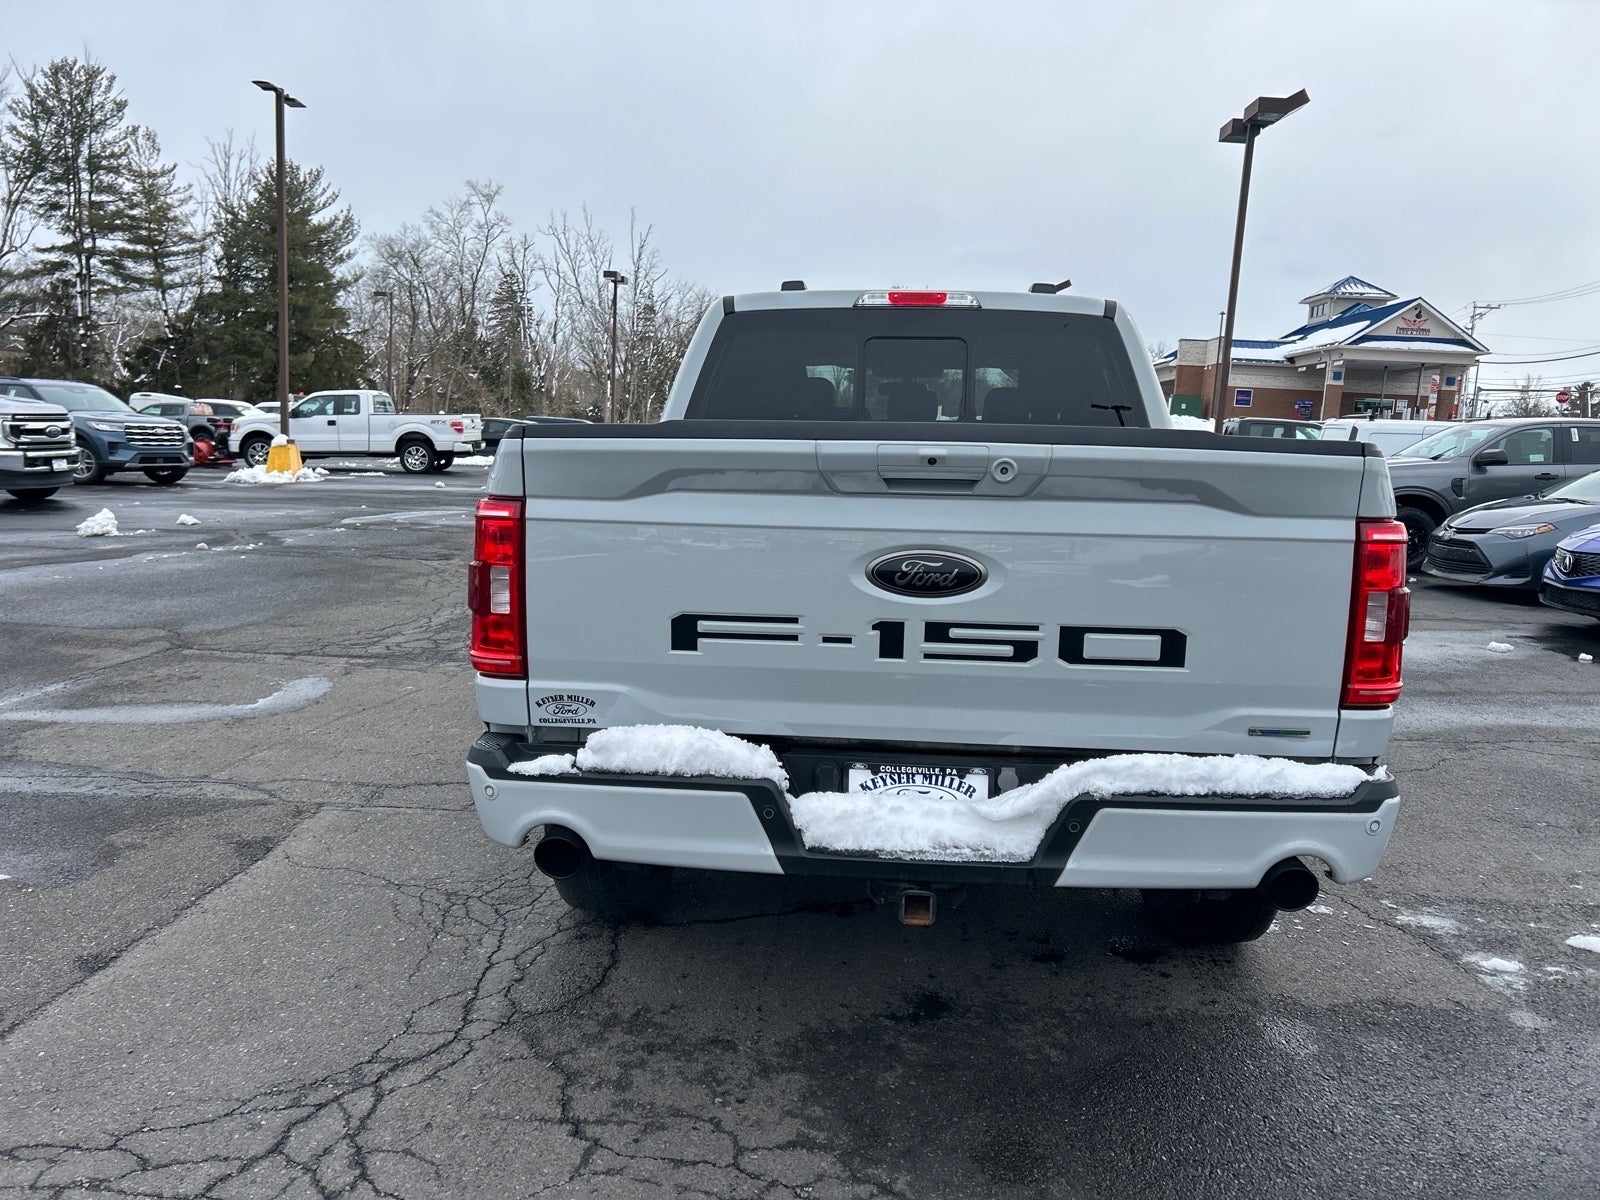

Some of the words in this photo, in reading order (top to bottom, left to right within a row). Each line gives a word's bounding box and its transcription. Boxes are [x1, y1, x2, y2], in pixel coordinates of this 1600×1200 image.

[894, 560, 958, 588] Ford
[670, 613, 1188, 670] F-150
[535, 694, 565, 708] KEYSER
[566, 694, 596, 708] MILLER
[553, 703, 580, 715] Ford
[946, 768, 958, 776] PA
[859, 773, 916, 791] KEYSER
[922, 774, 976, 799] MILLER
